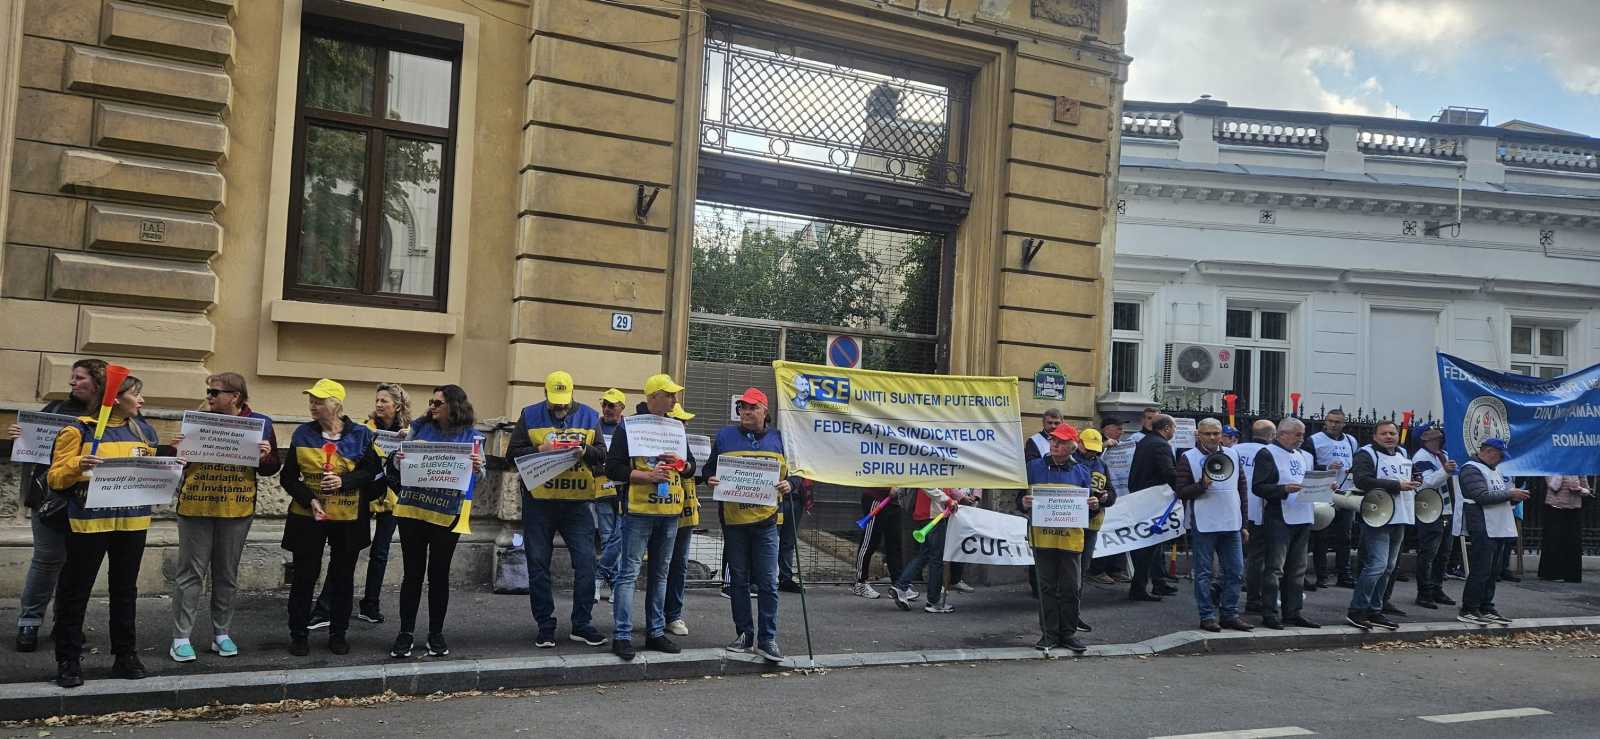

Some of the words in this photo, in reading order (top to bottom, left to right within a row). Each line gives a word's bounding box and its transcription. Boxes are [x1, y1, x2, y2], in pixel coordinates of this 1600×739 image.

[616, 315, 628, 328] 29
[808, 377, 849, 400] FSE
[854, 391, 886, 405] UNIȚI
[890, 392, 941, 406] SUNTEM
[944, 394, 1010, 407] PUTERNICI!
[1533, 407, 1553, 420] DIN
[814, 419, 896, 439] FEDERAȚIA
[897, 426, 995, 441] SINDICATELOR
[860, 441, 884, 455] DIN
[888, 443, 958, 461] EDUCAȚIE
[426, 468, 452, 477] Școala
[855, 461, 905, 477] „SPIRU
[909, 462, 967, 476] HARET”
[543, 478, 587, 490] SIBIU
